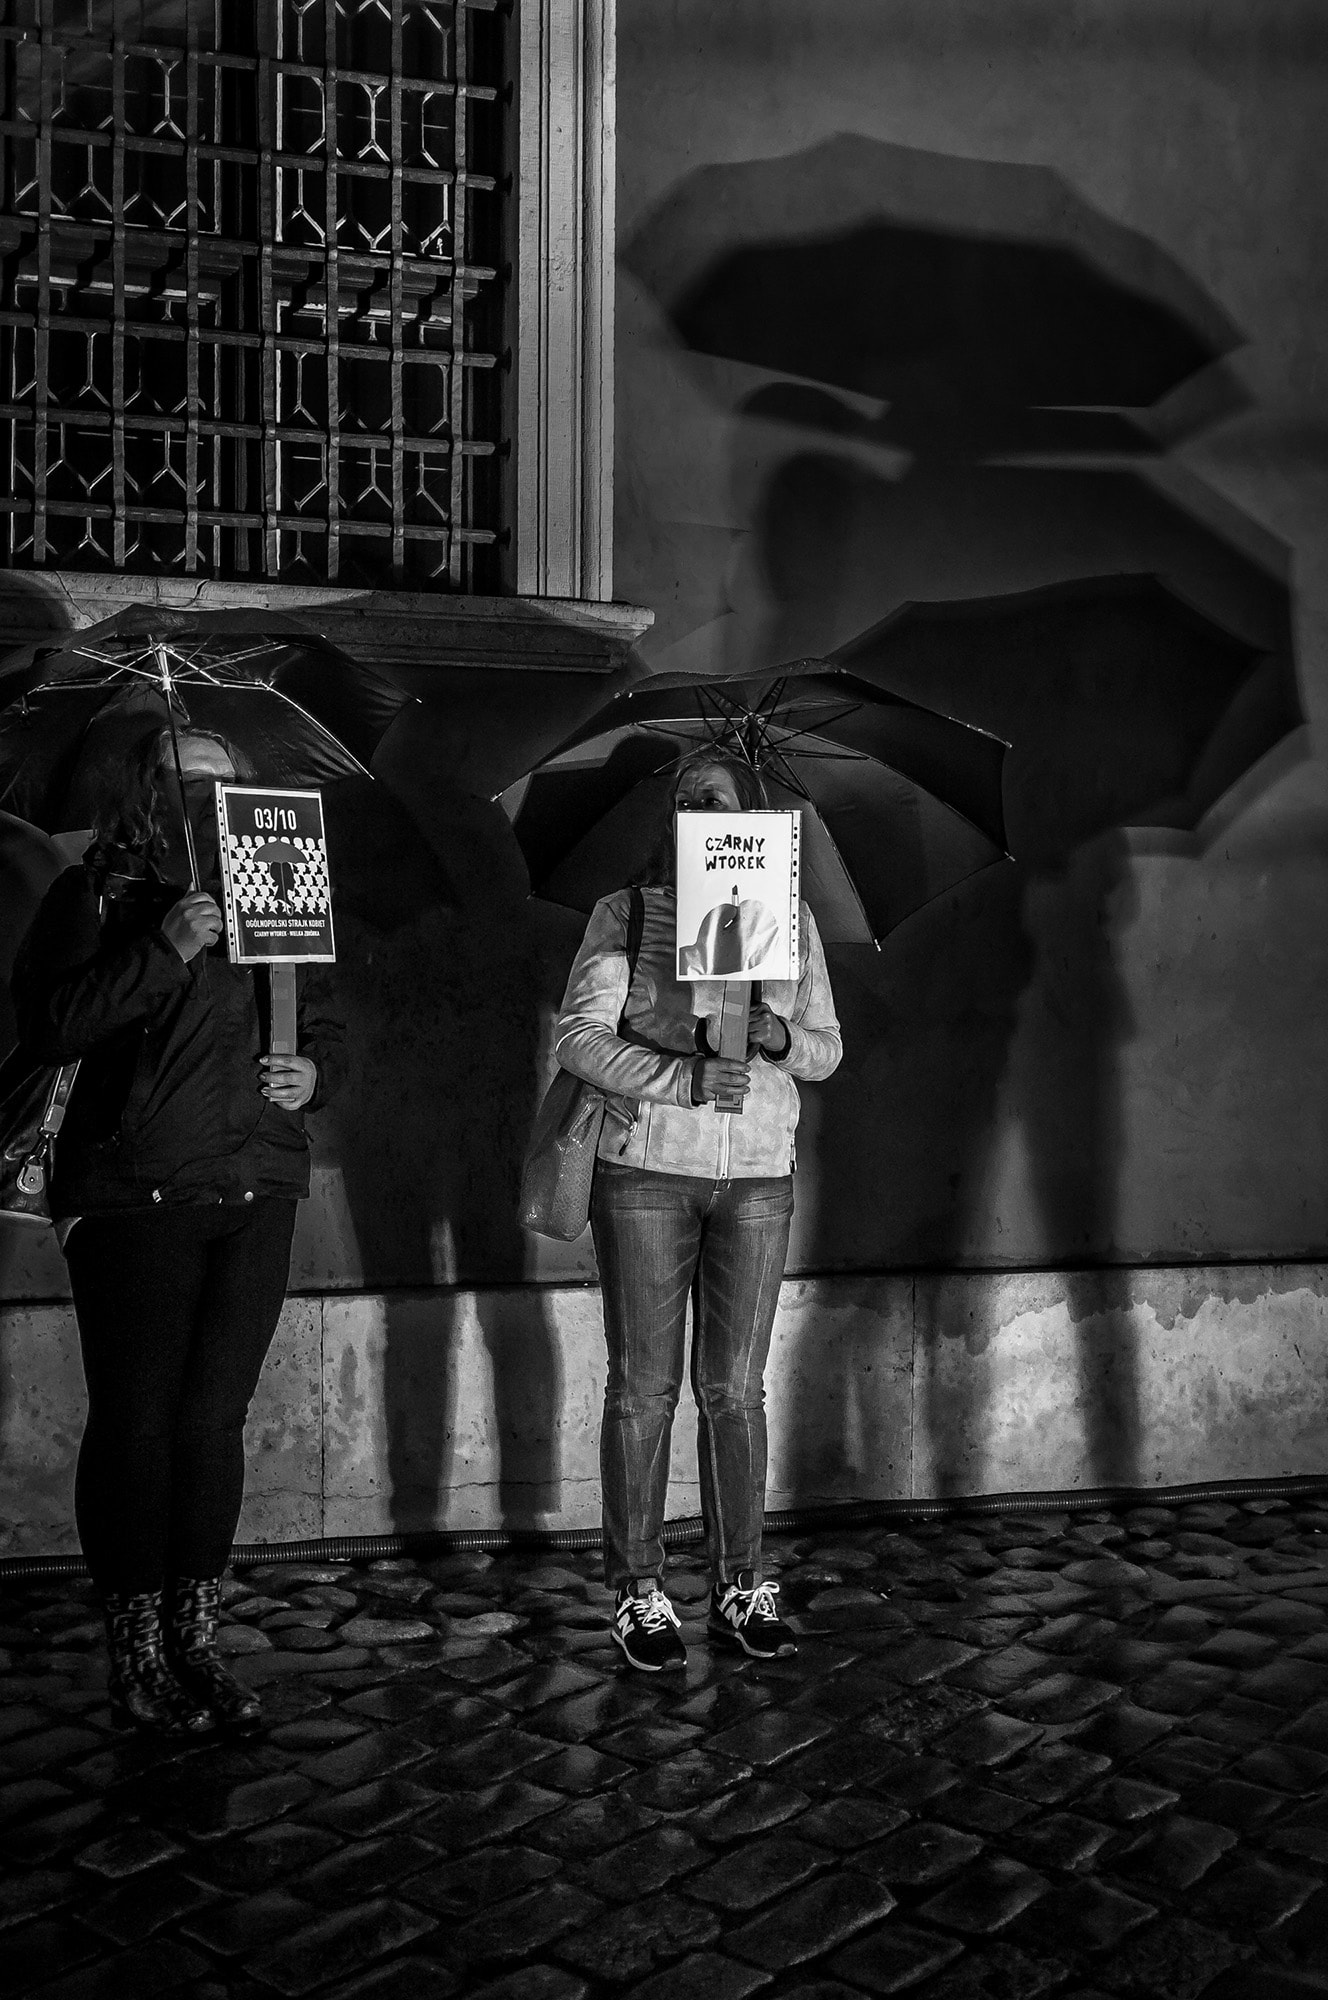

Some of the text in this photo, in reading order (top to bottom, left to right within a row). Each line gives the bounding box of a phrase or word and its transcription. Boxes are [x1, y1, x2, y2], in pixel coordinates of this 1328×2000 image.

[254, 807, 297, 831] 03/10
[705, 834, 765, 852] CZARNY
[705, 855, 765, 871] WTOREK
[245, 918, 287, 928] OGÓLNOPOLSKI
[288, 919, 308, 928] STRAJK
